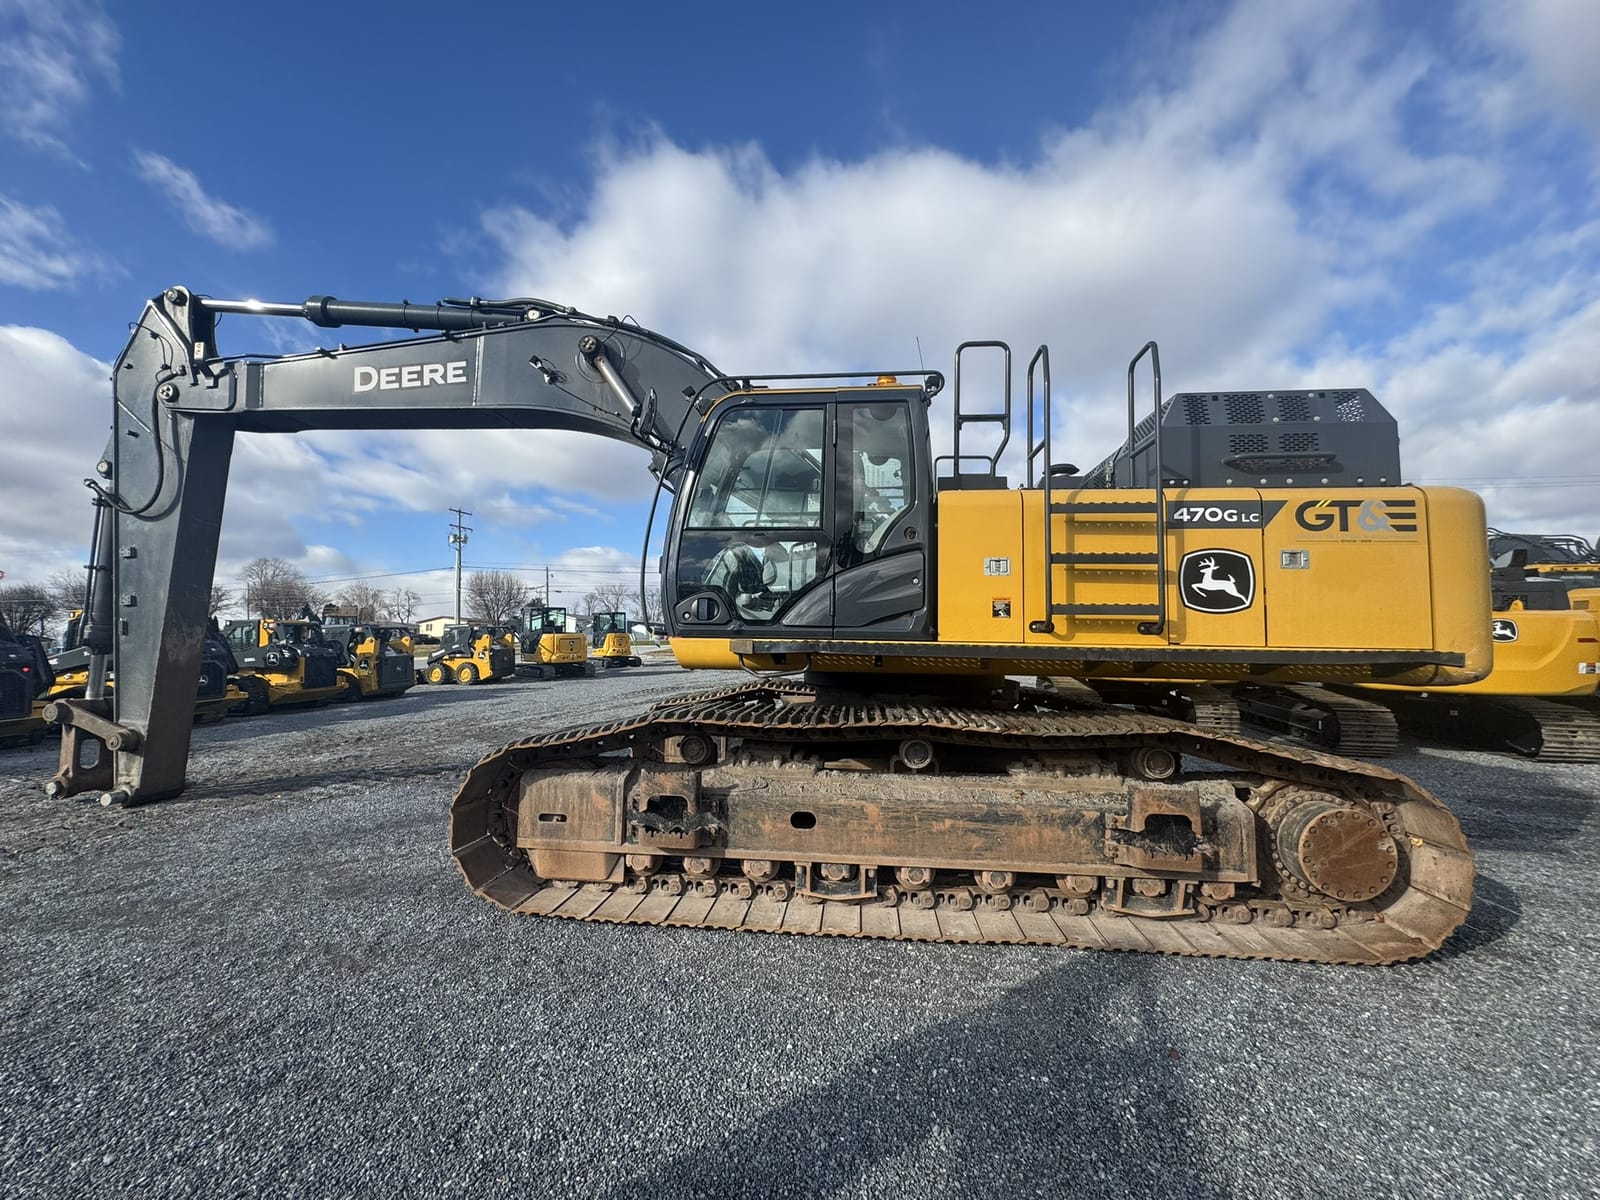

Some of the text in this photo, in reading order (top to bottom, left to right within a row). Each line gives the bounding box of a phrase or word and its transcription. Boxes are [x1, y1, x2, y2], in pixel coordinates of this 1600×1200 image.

[353, 361, 467, 393] DEERE
[1173, 507, 1260, 523] 470G LC
[1295, 499, 1416, 532] GT&E
